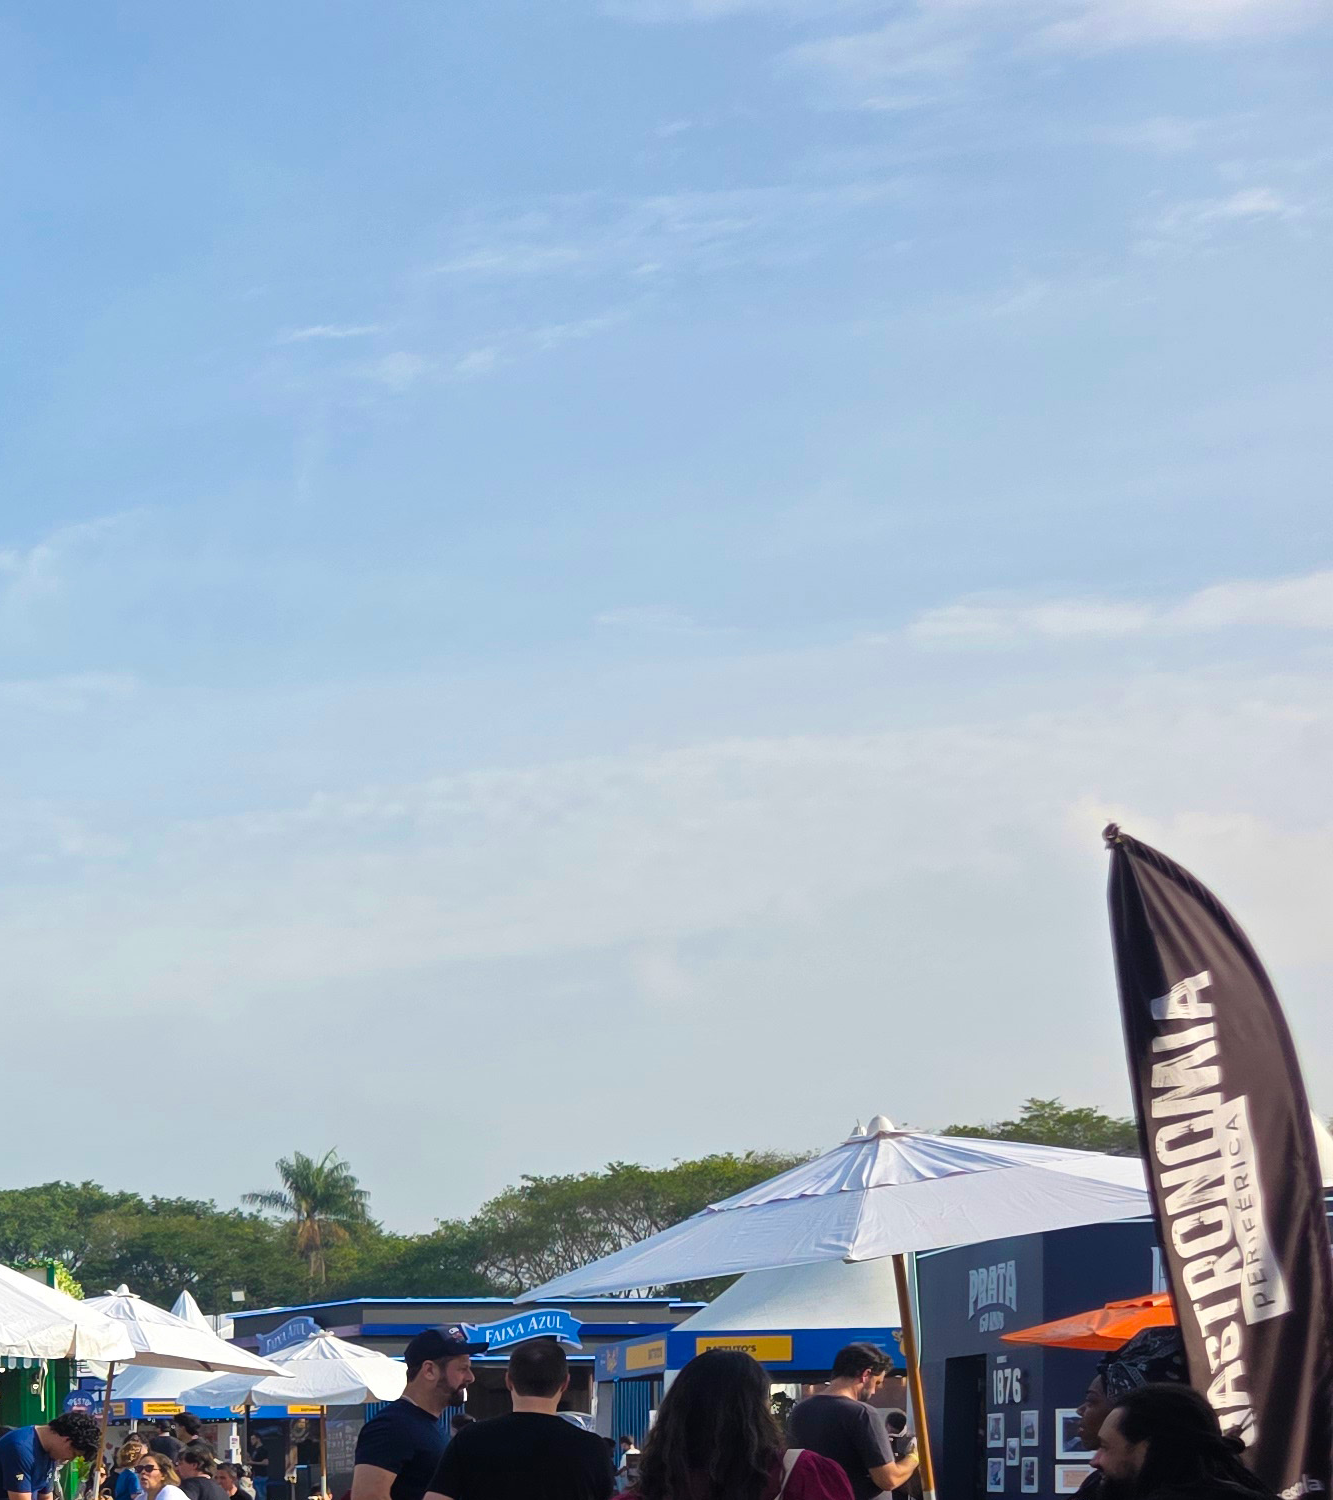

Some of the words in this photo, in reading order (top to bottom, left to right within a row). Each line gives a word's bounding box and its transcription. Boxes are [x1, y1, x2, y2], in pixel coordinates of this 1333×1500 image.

[1225, 1113, 1277, 1309] PERIFÉRICA
[968, 1260, 1017, 1320] PRATA
[485, 1323, 524, 1342] FAIXA
[528, 1315, 564, 1332] AZUL
[993, 1368, 1021, 1405] 1876
